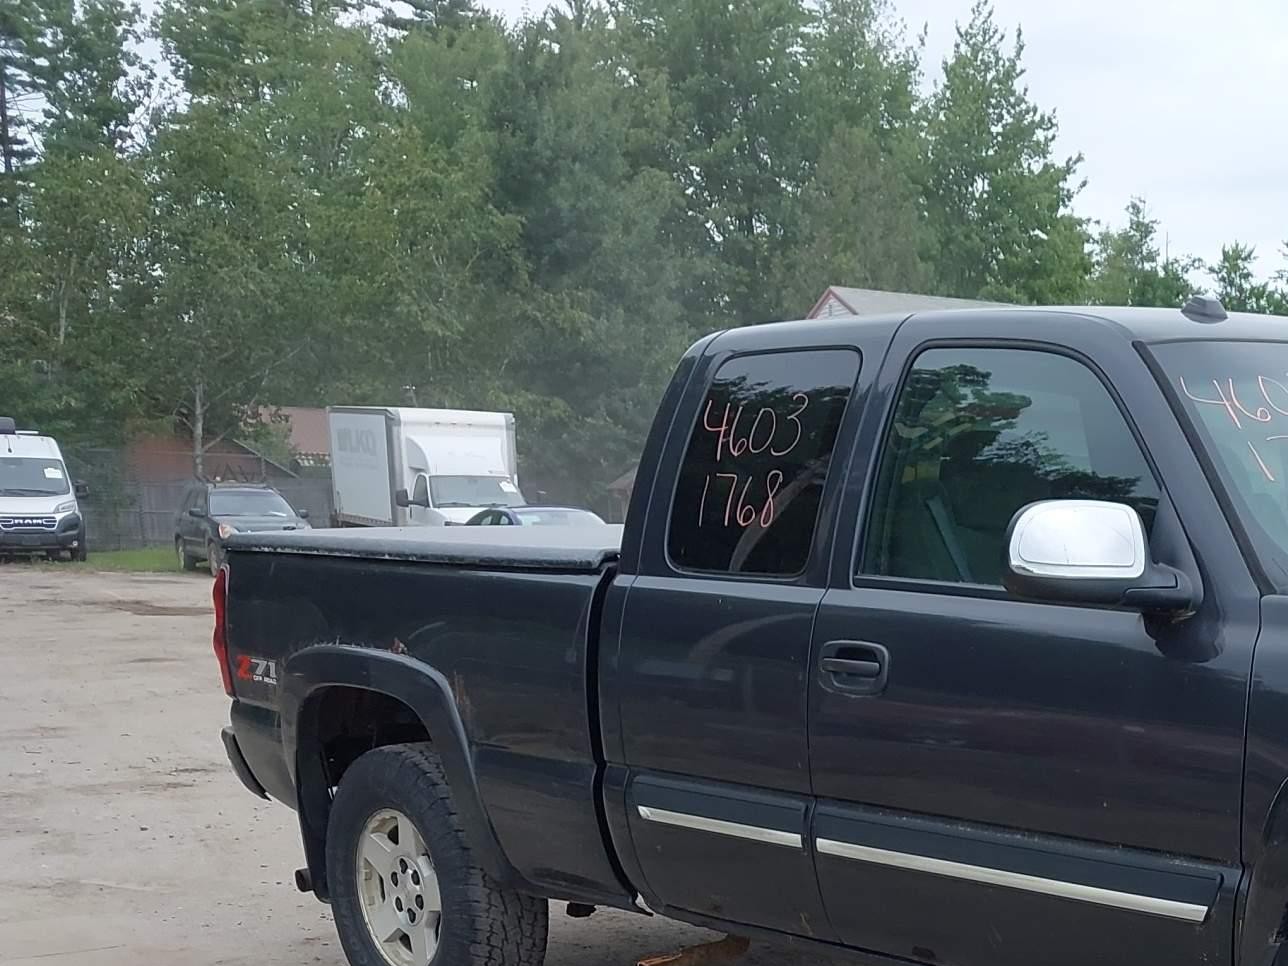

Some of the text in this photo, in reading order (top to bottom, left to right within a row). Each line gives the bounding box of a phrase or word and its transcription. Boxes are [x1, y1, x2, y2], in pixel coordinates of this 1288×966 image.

[703, 393, 809, 461] 4603
[697, 469, 784, 529] 1768
[237, 655, 277, 680] Z71
